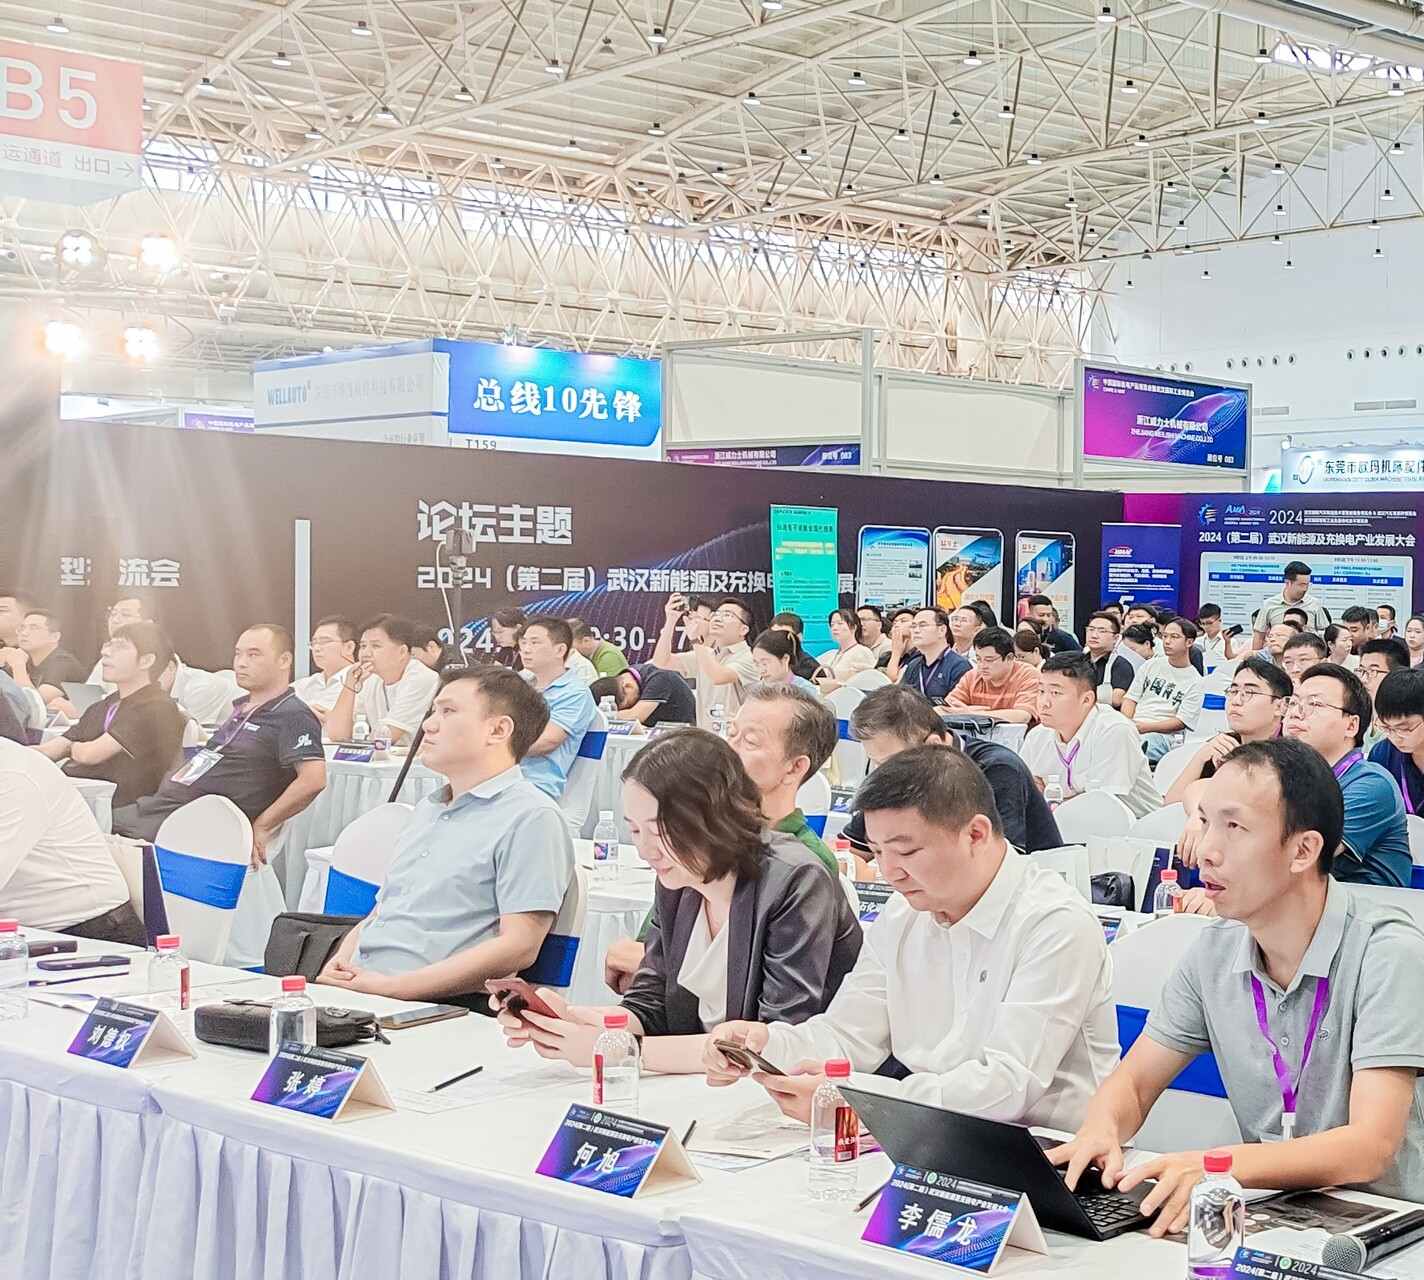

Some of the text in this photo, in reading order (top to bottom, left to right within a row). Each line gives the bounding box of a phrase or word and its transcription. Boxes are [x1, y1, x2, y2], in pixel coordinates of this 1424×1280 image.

[0, 56, 97, 129] B5
[473, 376, 643, 424] 总线10先锋
[417, 500, 573, 545] 论坛主题
[1269, 509, 1303, 525] 2024
[573, 1141, 621, 1174] 何旭
[936, 1175, 958, 1189] 2024
[897, 1202, 978, 1246] 李儒龙
[1291, 1261, 1319, 1276] 2024
